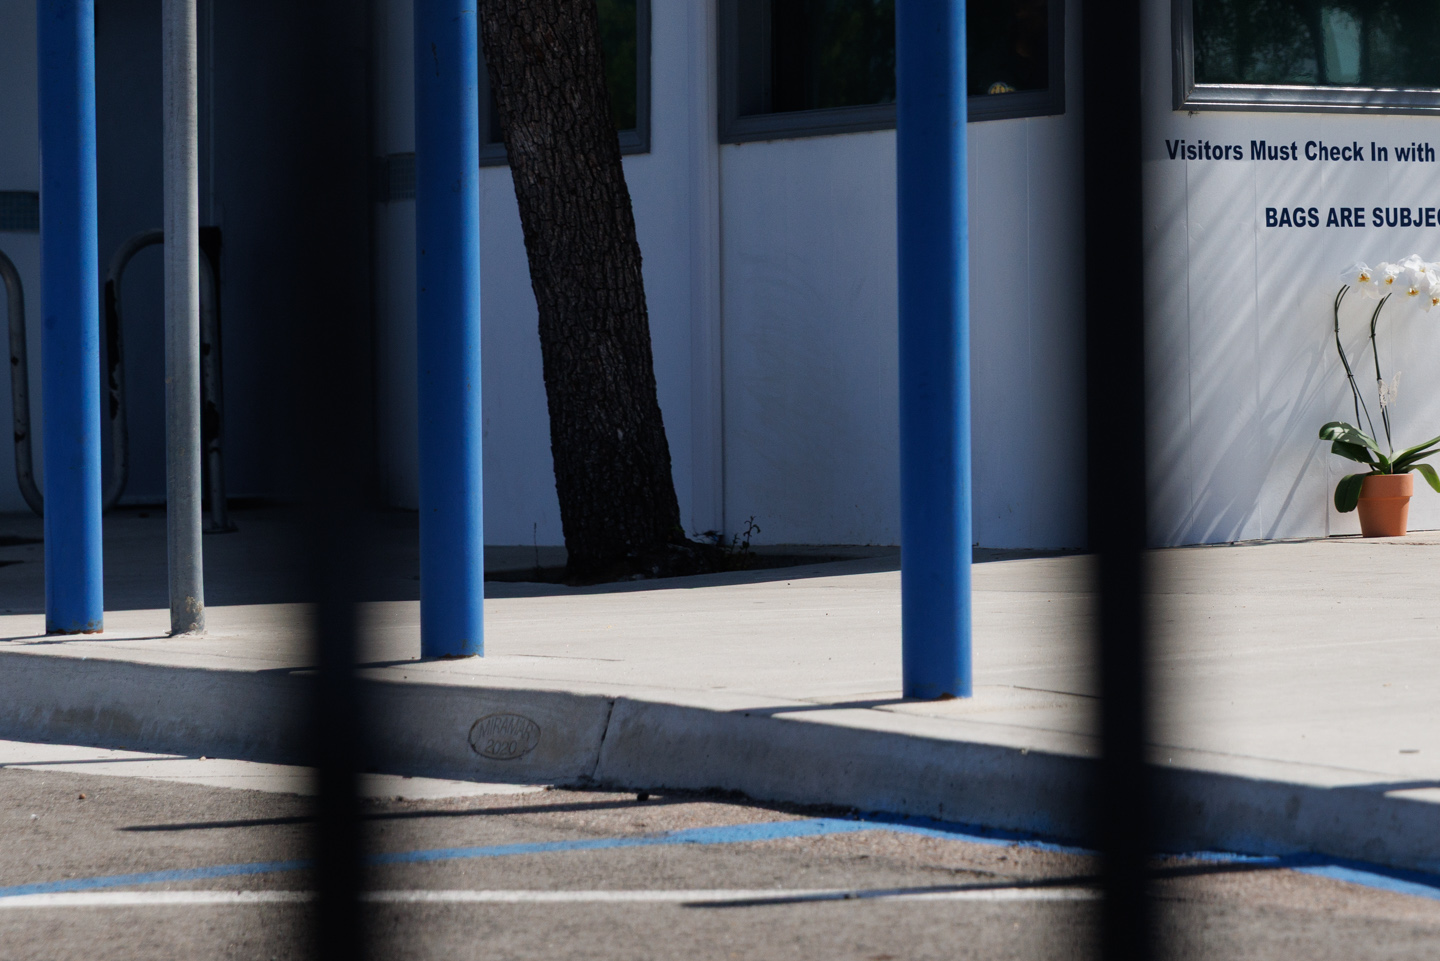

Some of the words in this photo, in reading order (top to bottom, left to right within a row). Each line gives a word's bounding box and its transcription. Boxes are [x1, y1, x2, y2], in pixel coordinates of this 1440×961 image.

[1165, 139, 1244, 161] Visitors
[1250, 140, 1298, 161] Must
[1304, 141, 1365, 162] Check
[1371, 141, 1389, 162] In
[1394, 142, 1436, 163] with
[1265, 207, 1320, 228] BAGS
[1326, 207, 1366, 228] ARE
[485, 739, 518, 755] 2020
